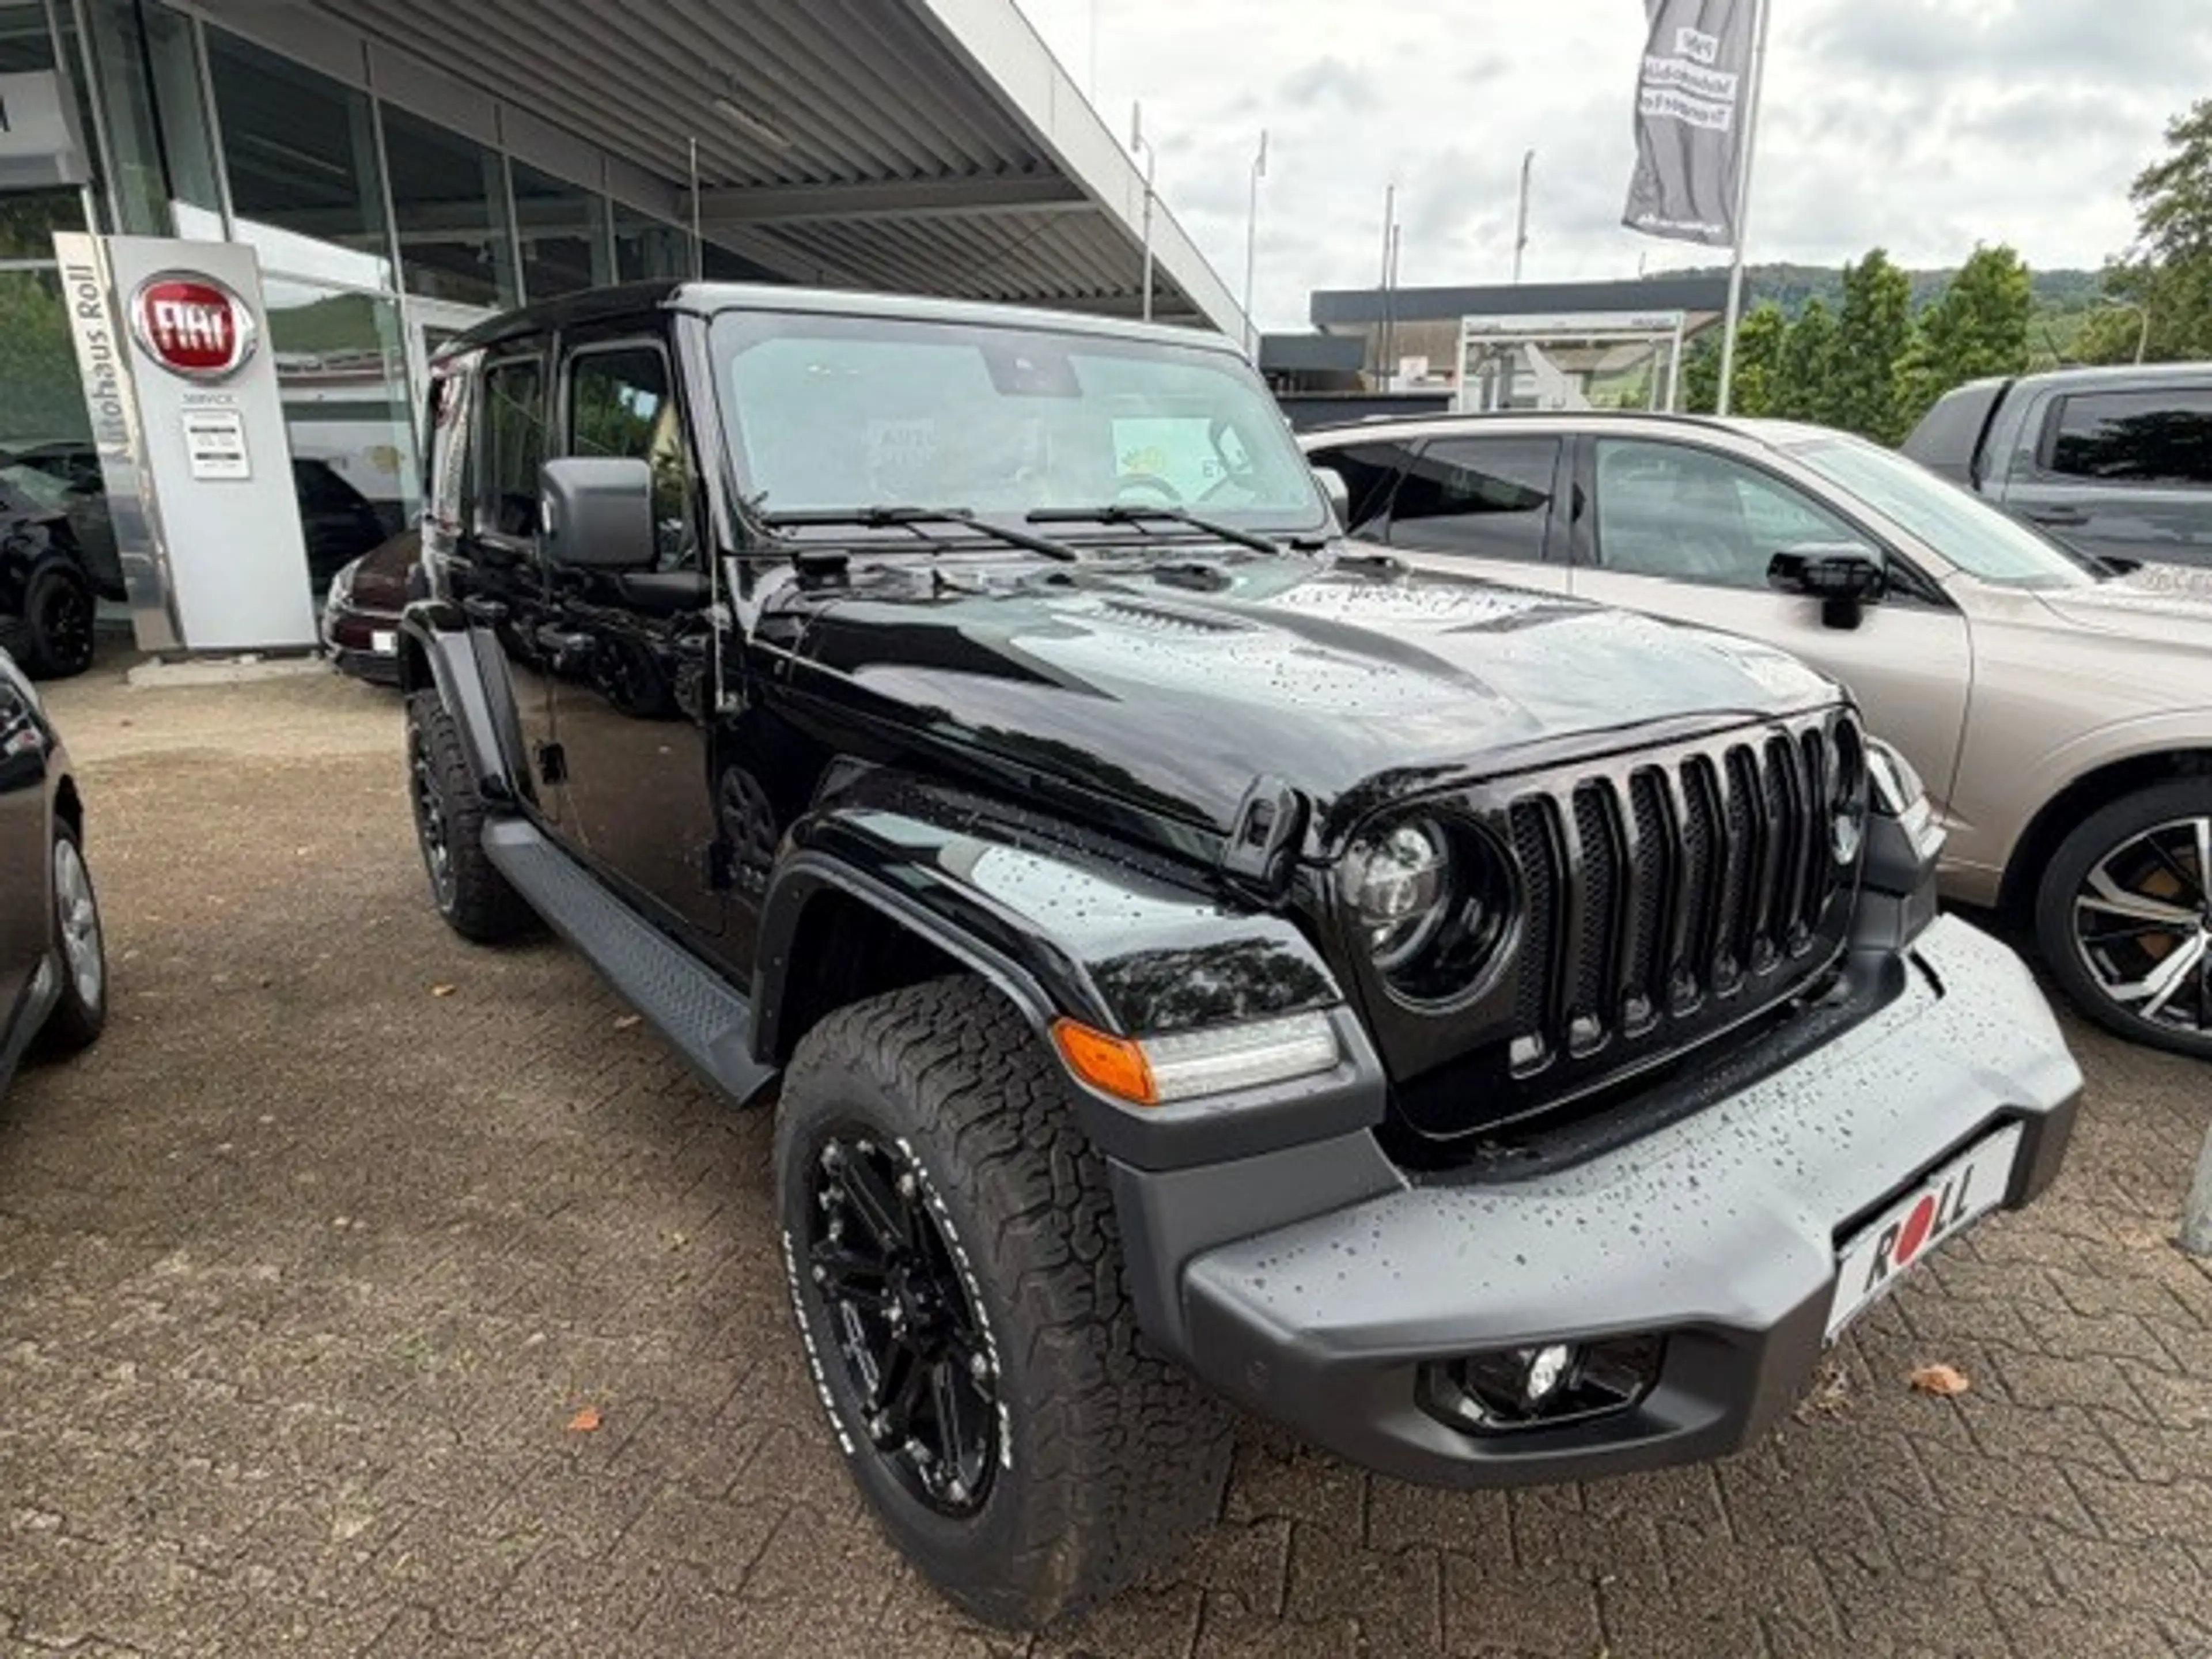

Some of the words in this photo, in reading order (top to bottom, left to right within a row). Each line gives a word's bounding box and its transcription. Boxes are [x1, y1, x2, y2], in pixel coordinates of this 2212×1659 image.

[66, 265, 104, 319] Roll
[153, 300, 227, 353] FIAT
[86, 330, 132, 464] Autohaus
